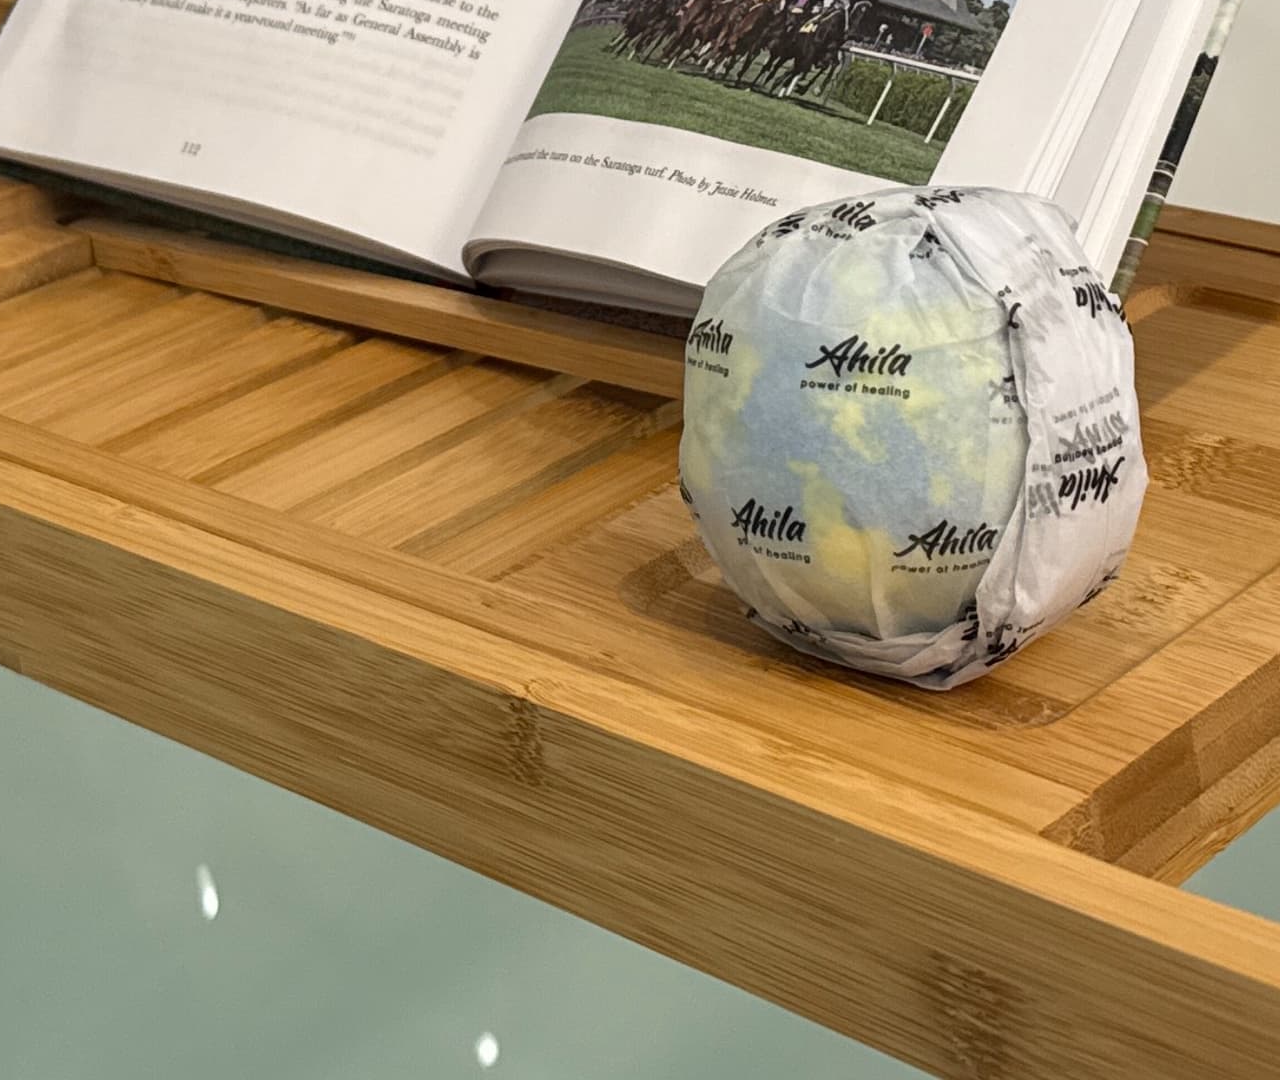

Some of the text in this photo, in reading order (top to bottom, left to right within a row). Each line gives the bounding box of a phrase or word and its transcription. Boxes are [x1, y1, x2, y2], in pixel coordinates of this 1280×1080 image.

[223, 10, 231, 19] a
[459, 0, 473, 12] to
[476, 4, 499, 21] the
[314, 4, 332, 18] far
[334, 13, 348, 22] as
[352, 13, 402, 35] General
[402, 27, 466, 57] Assembly
[467, 45, 481, 60] is
[436, 17, 491, 44] meeting
[569, 153, 582, 163] on
[583, 154, 601, 167] the
[601, 156, 642, 176] Saratoga
[668, 169, 697, 187] Photo
[697, 177, 712, 193] by
[805, 334, 913, 377] Ahila
[705, 362, 730, 378] healing
[800, 378, 911, 399] power of healing
[731, 498, 807, 542] Ahila
[893, 519, 998, 560] Ahila
[765, 548, 811, 564] healing
